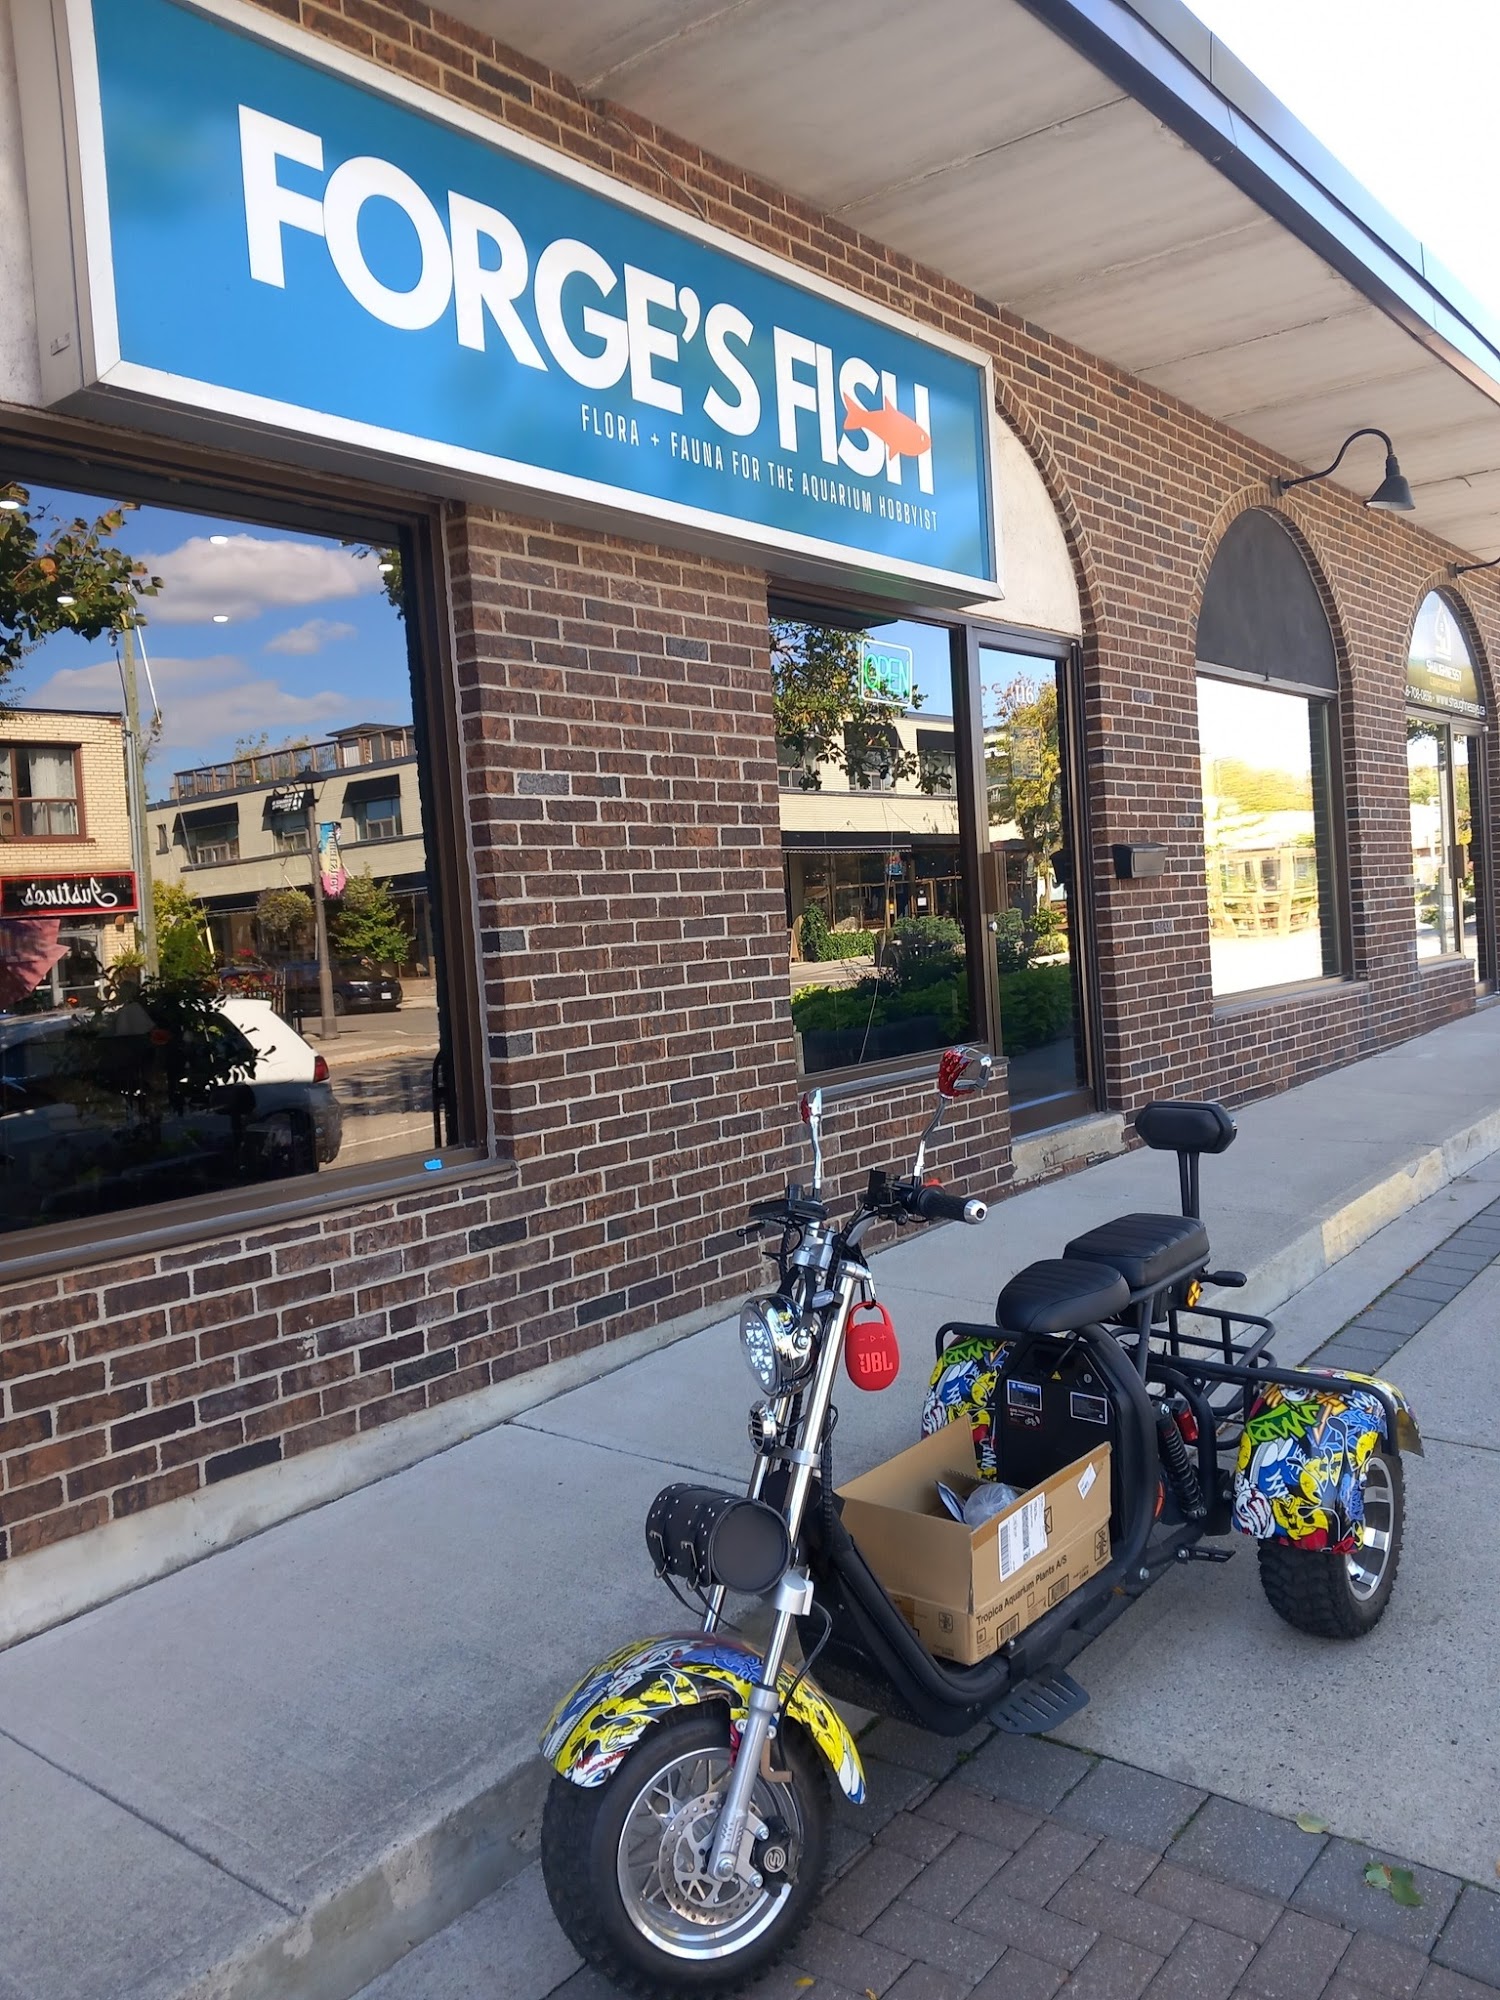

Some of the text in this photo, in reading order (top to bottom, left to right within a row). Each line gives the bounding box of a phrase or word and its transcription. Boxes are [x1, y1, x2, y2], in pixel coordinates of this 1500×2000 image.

[773, 325, 935, 495] FISH
[581, 403, 640, 447] FLORA
[671, 431, 724, 471] FAUNA
[733, 450, 761, 482] FOR
[768, 461, 795, 492] THE
[802, 472, 873, 515] AQUARIUM
[879, 494, 938, 532] HOBBYIST
[864, 653, 910, 698] OPEN
[1015, 684, 1035, 704] 116
[858, 1351, 893, 1374] JBL
[976, 1603, 1004, 1626] Tropica
[1004, 1581, 1035, 1608] Aquarium
[1035, 1564, 1055, 1587] Plants
[1055, 1554, 1068, 1570] A/S
